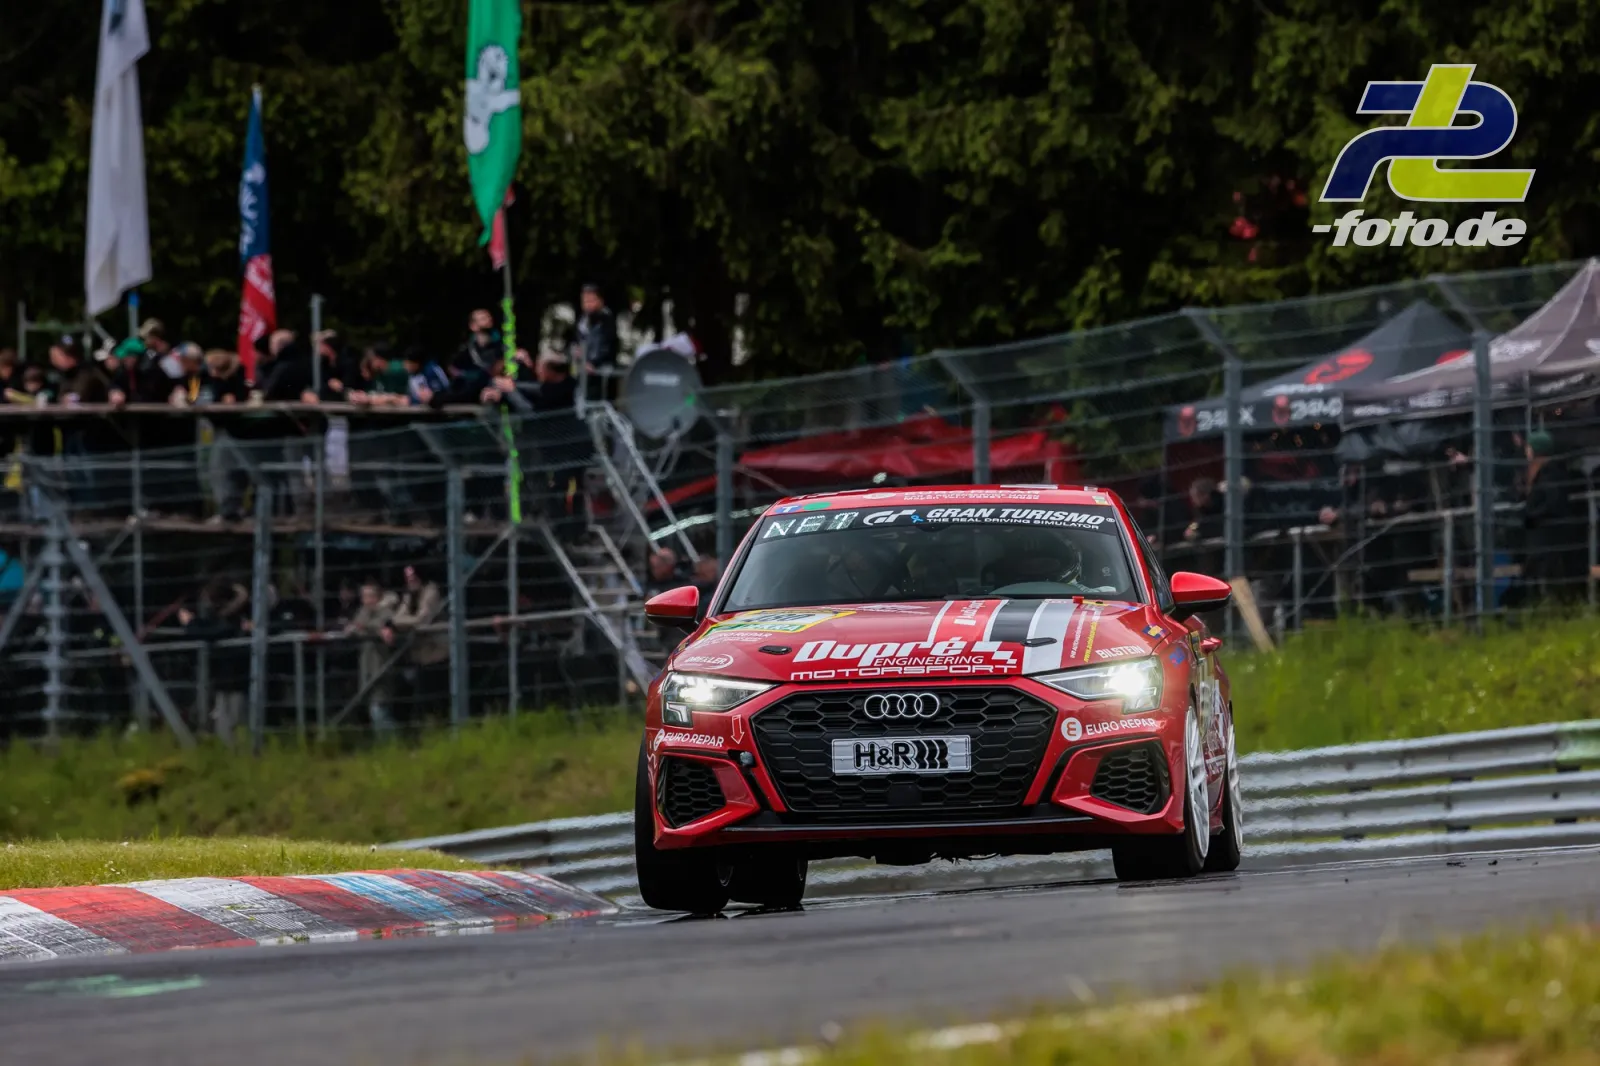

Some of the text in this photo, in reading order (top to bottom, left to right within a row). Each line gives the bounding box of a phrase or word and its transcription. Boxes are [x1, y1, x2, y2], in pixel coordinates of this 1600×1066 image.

[926, 508, 995, 518] GRAN
[1033, 520, 1100, 530] SIMULATOR
[792, 636, 968, 667] Dupré
[1095, 645, 1145, 659] BILSTEIN
[874, 656, 984, 667] ENGINEERING
[790, 665, 1017, 680] MOTORSPORT
[1086, 721, 1119, 736] EURO
[1121, 717, 1158, 729] REPAR
[664, 732, 690, 743] EURO
[690, 733, 725, 747] REPAR
[854, 742, 914, 768] H&R
